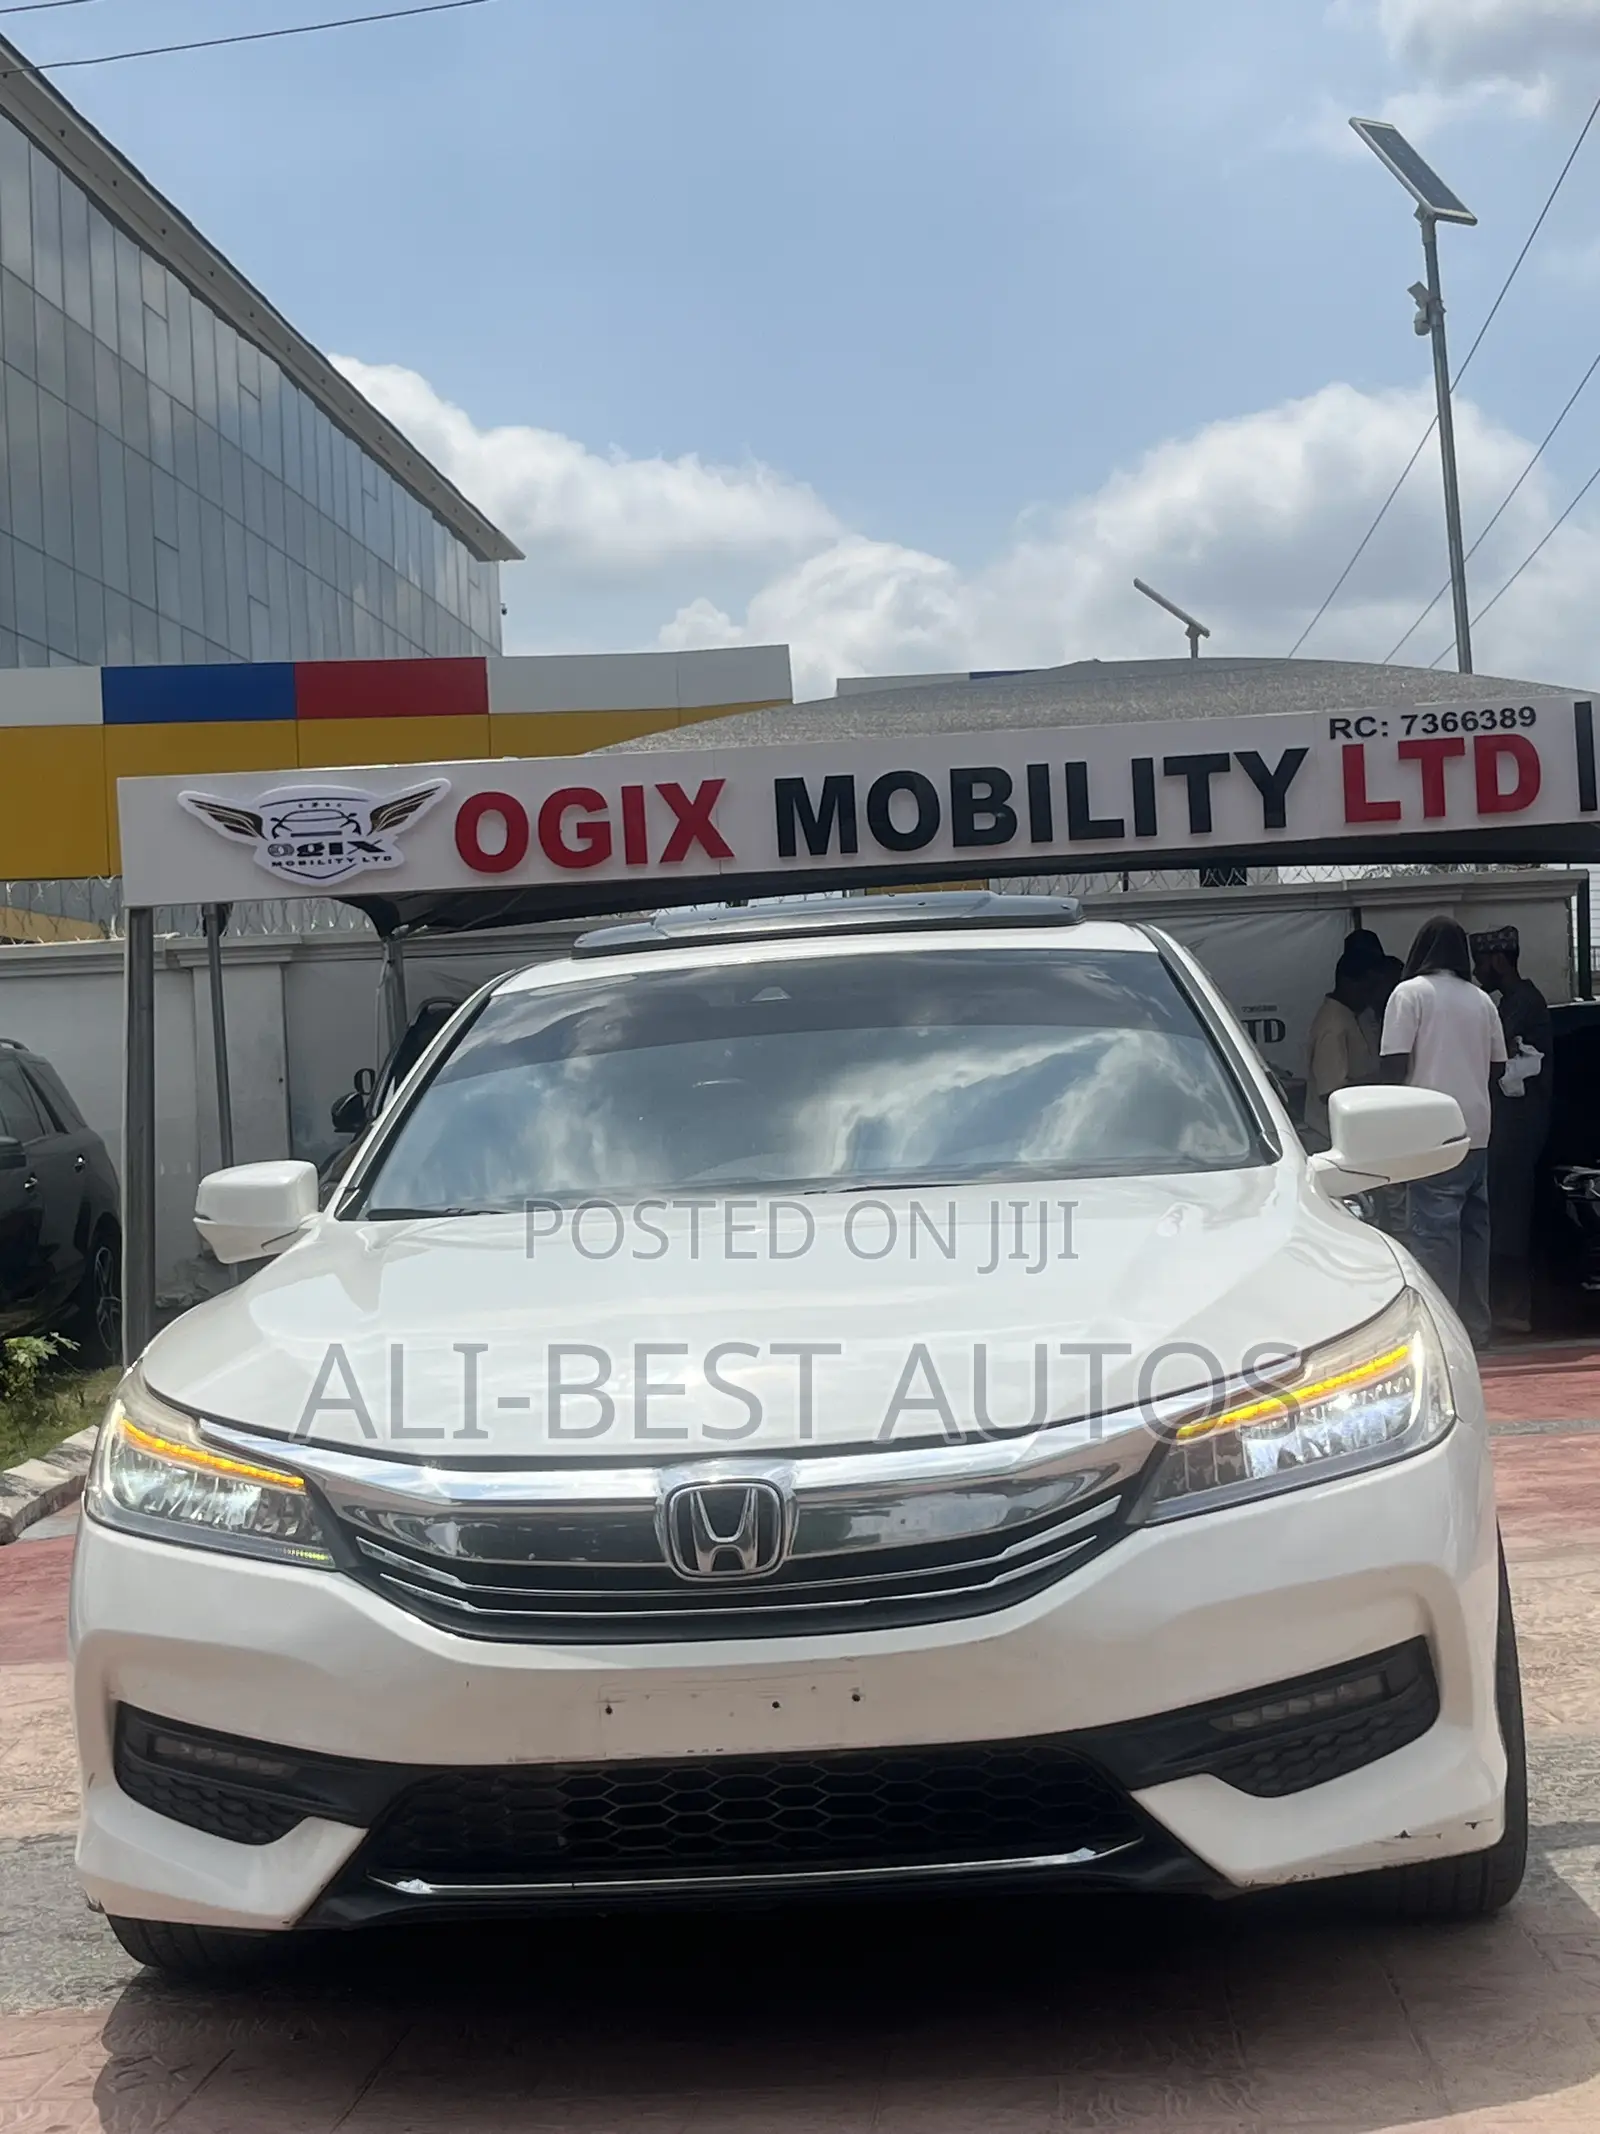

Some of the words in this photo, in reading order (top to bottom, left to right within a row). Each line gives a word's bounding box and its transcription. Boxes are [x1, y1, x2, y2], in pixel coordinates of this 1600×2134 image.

[1329, 716, 1389, 740] RC:
[1400, 706, 1537, 736] 7366389
[455, 778, 735, 873] OGIX
[774, 747, 1309, 858] MOBILITY
[1342, 733, 1541, 823] LTD
[271, 856, 355, 867] MOBILITY
[362, 855, 392, 863] LTD
[1241, 1018, 1286, 1044] TD
